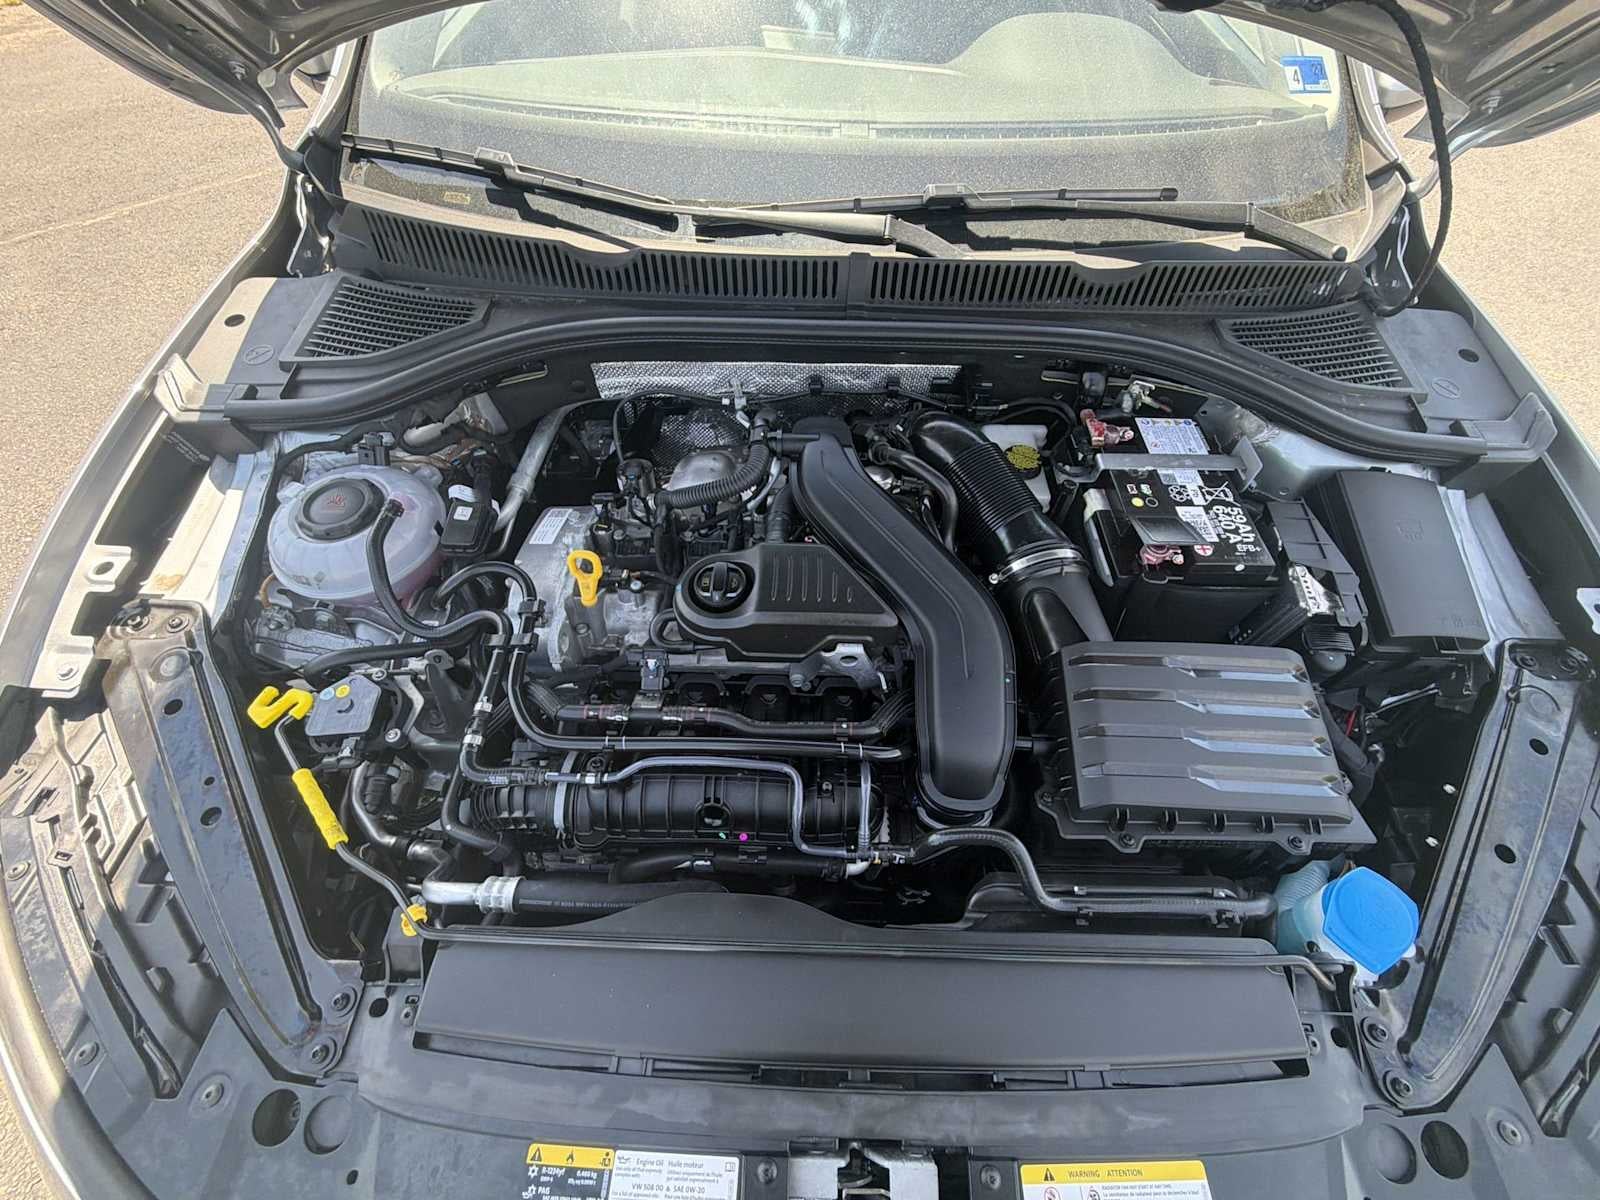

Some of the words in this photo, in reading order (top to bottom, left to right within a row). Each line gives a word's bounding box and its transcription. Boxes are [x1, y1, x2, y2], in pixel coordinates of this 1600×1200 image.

[1293, 68, 1301, 85] 4
[1212, 505, 1236, 530] 640
[1224, 532, 1243, 544] A
[1227, 506, 1256, 543] 59Ah
[1069, 1168, 1100, 1178] WARNING
[1107, 1168, 1143, 1177] ATTENTION
